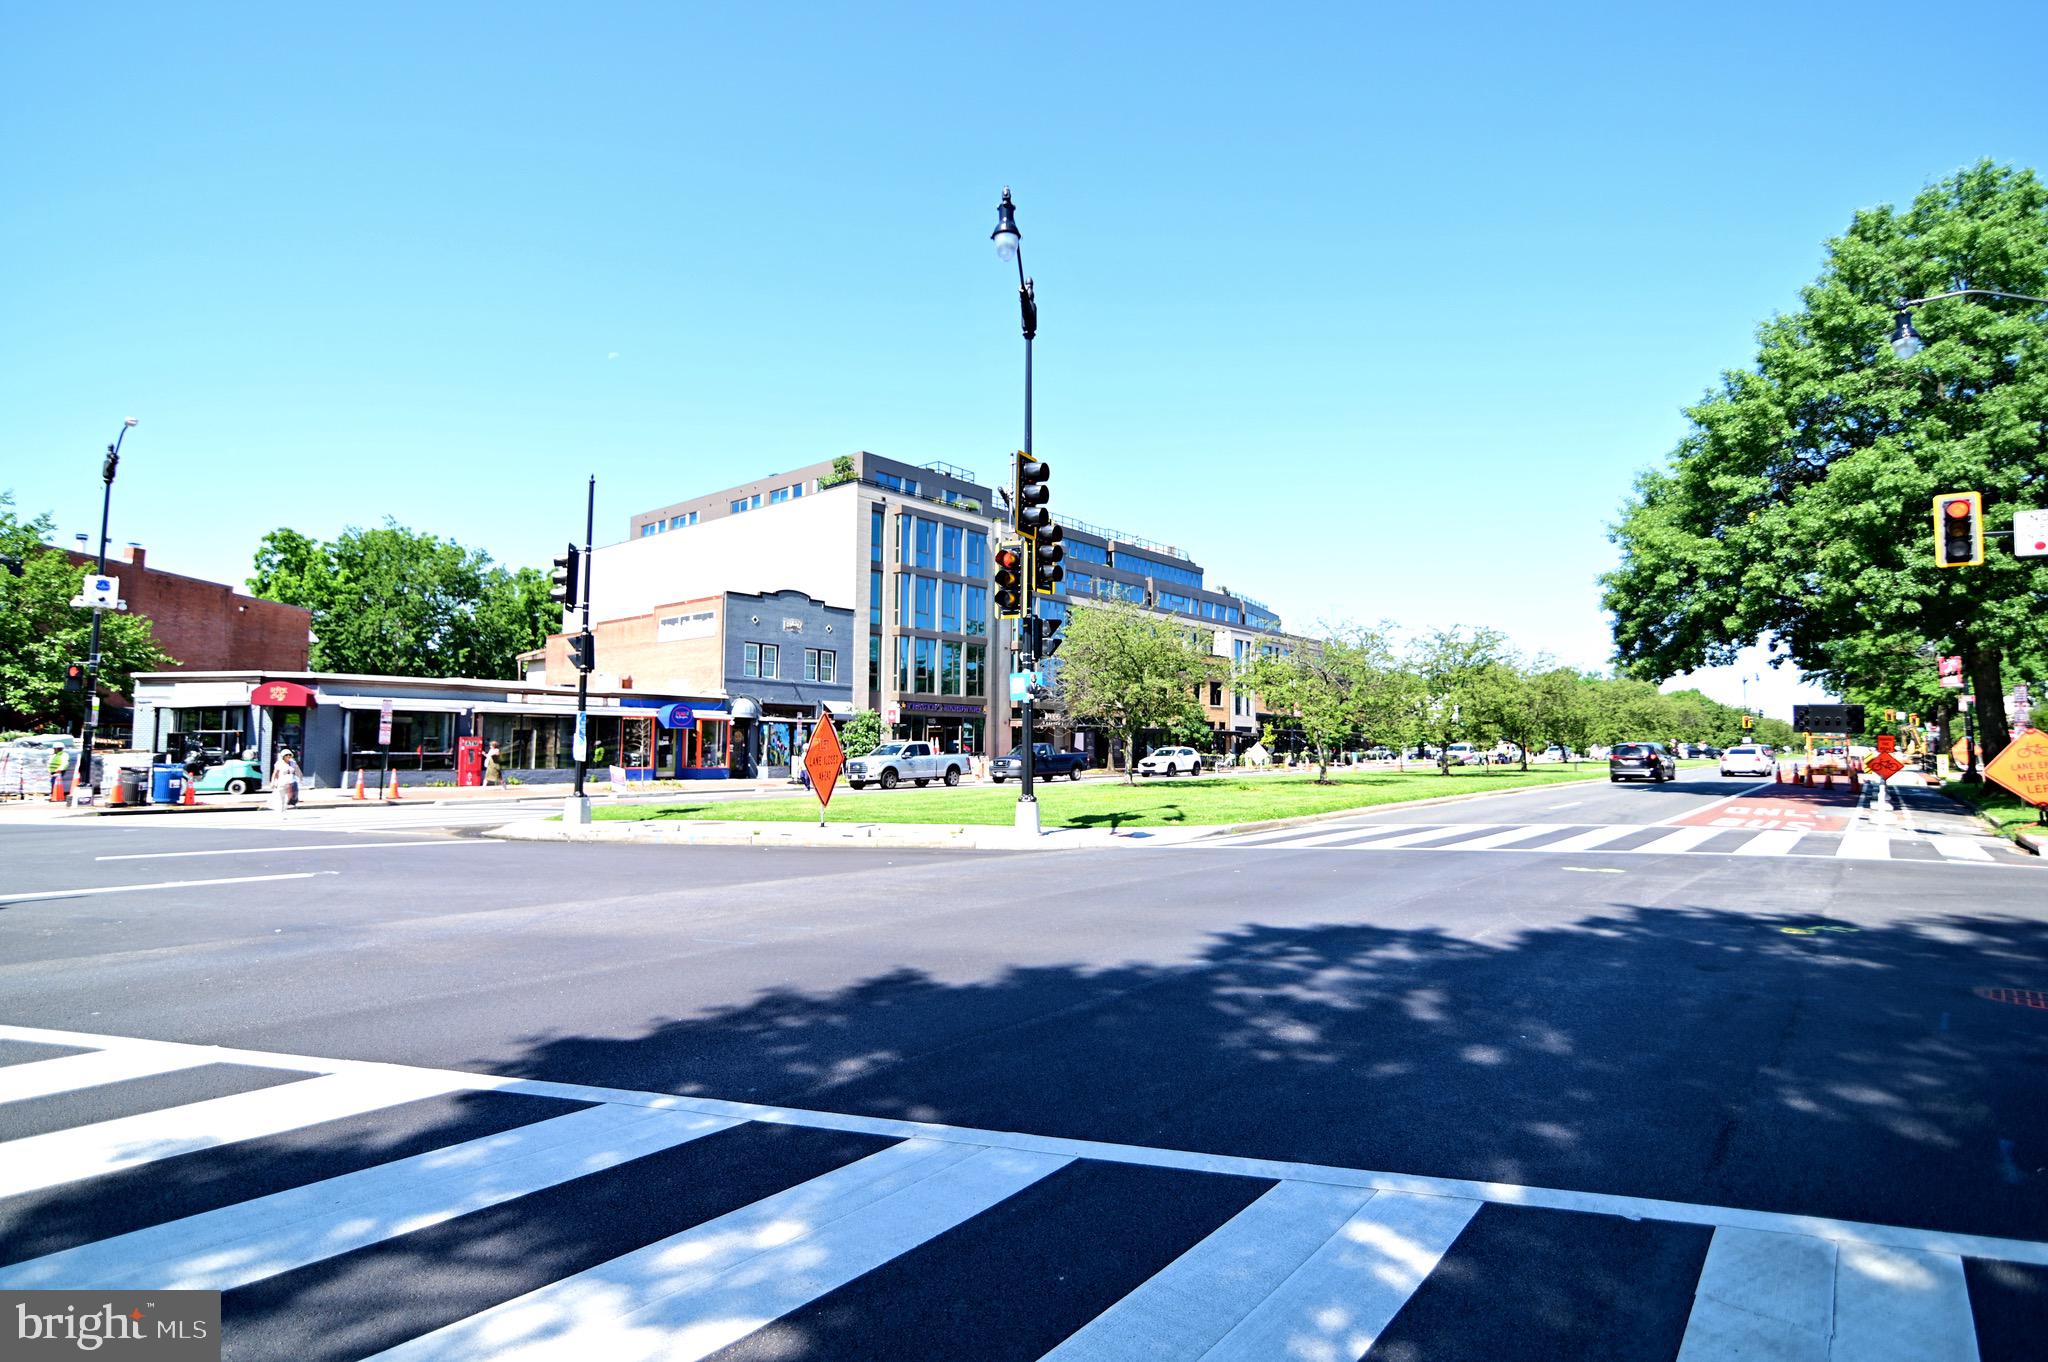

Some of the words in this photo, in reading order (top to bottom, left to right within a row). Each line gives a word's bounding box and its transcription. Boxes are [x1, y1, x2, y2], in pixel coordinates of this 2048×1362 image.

[810, 756, 822, 766] LANE
[2011, 762, 2035, 771] LANE
[1708, 818, 1817, 831] BUS
